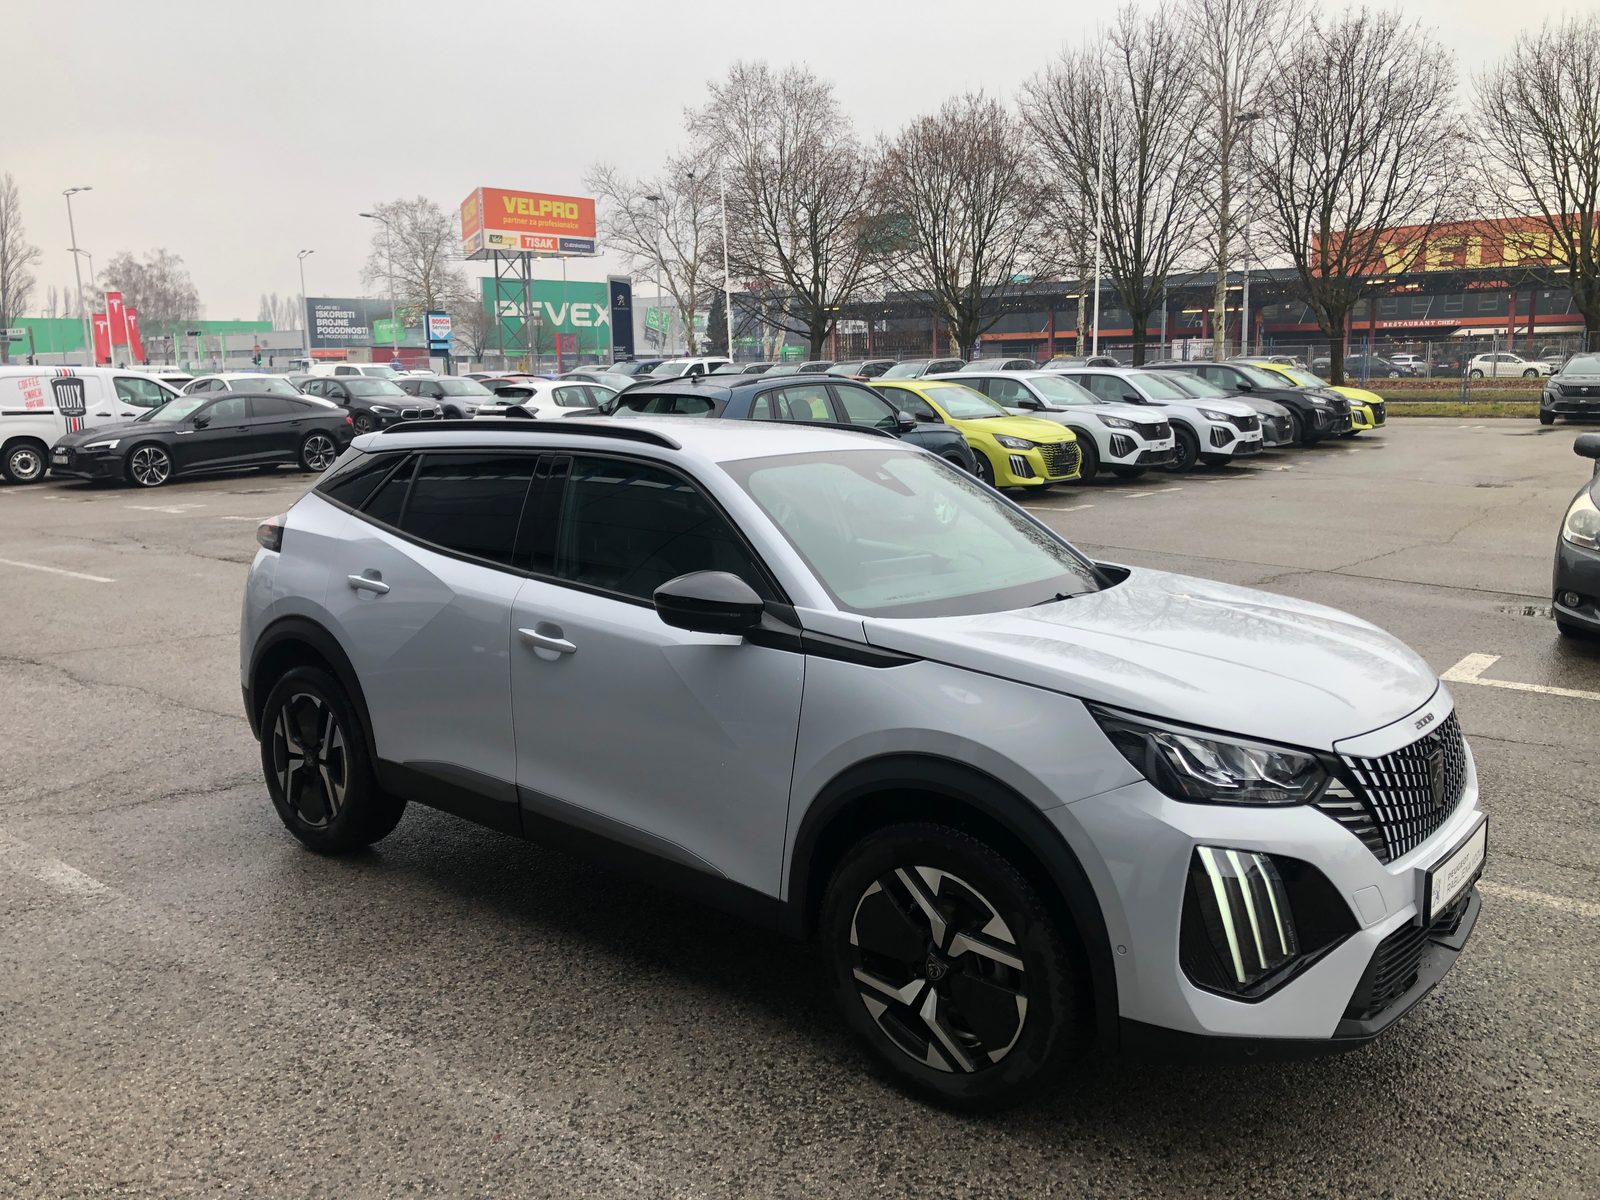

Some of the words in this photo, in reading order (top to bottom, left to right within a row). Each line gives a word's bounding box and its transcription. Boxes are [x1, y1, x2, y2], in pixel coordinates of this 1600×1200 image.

[502, 196, 579, 219] VELPRO
[502, 216, 528, 225] partner
[538, 219, 579, 229] profesionalce
[524, 237, 554, 249] TISAK
[315, 310, 355, 319] ISKORISTI
[316, 318, 349, 326] BROJNE
[17, 376, 40, 390] COFFEE
[24, 388, 43, 400] SNACK
[56, 384, 83, 408] QUIX
[1414, 713, 1435, 730] 2008
[1447, 852, 1470, 880] PEUGEOT
